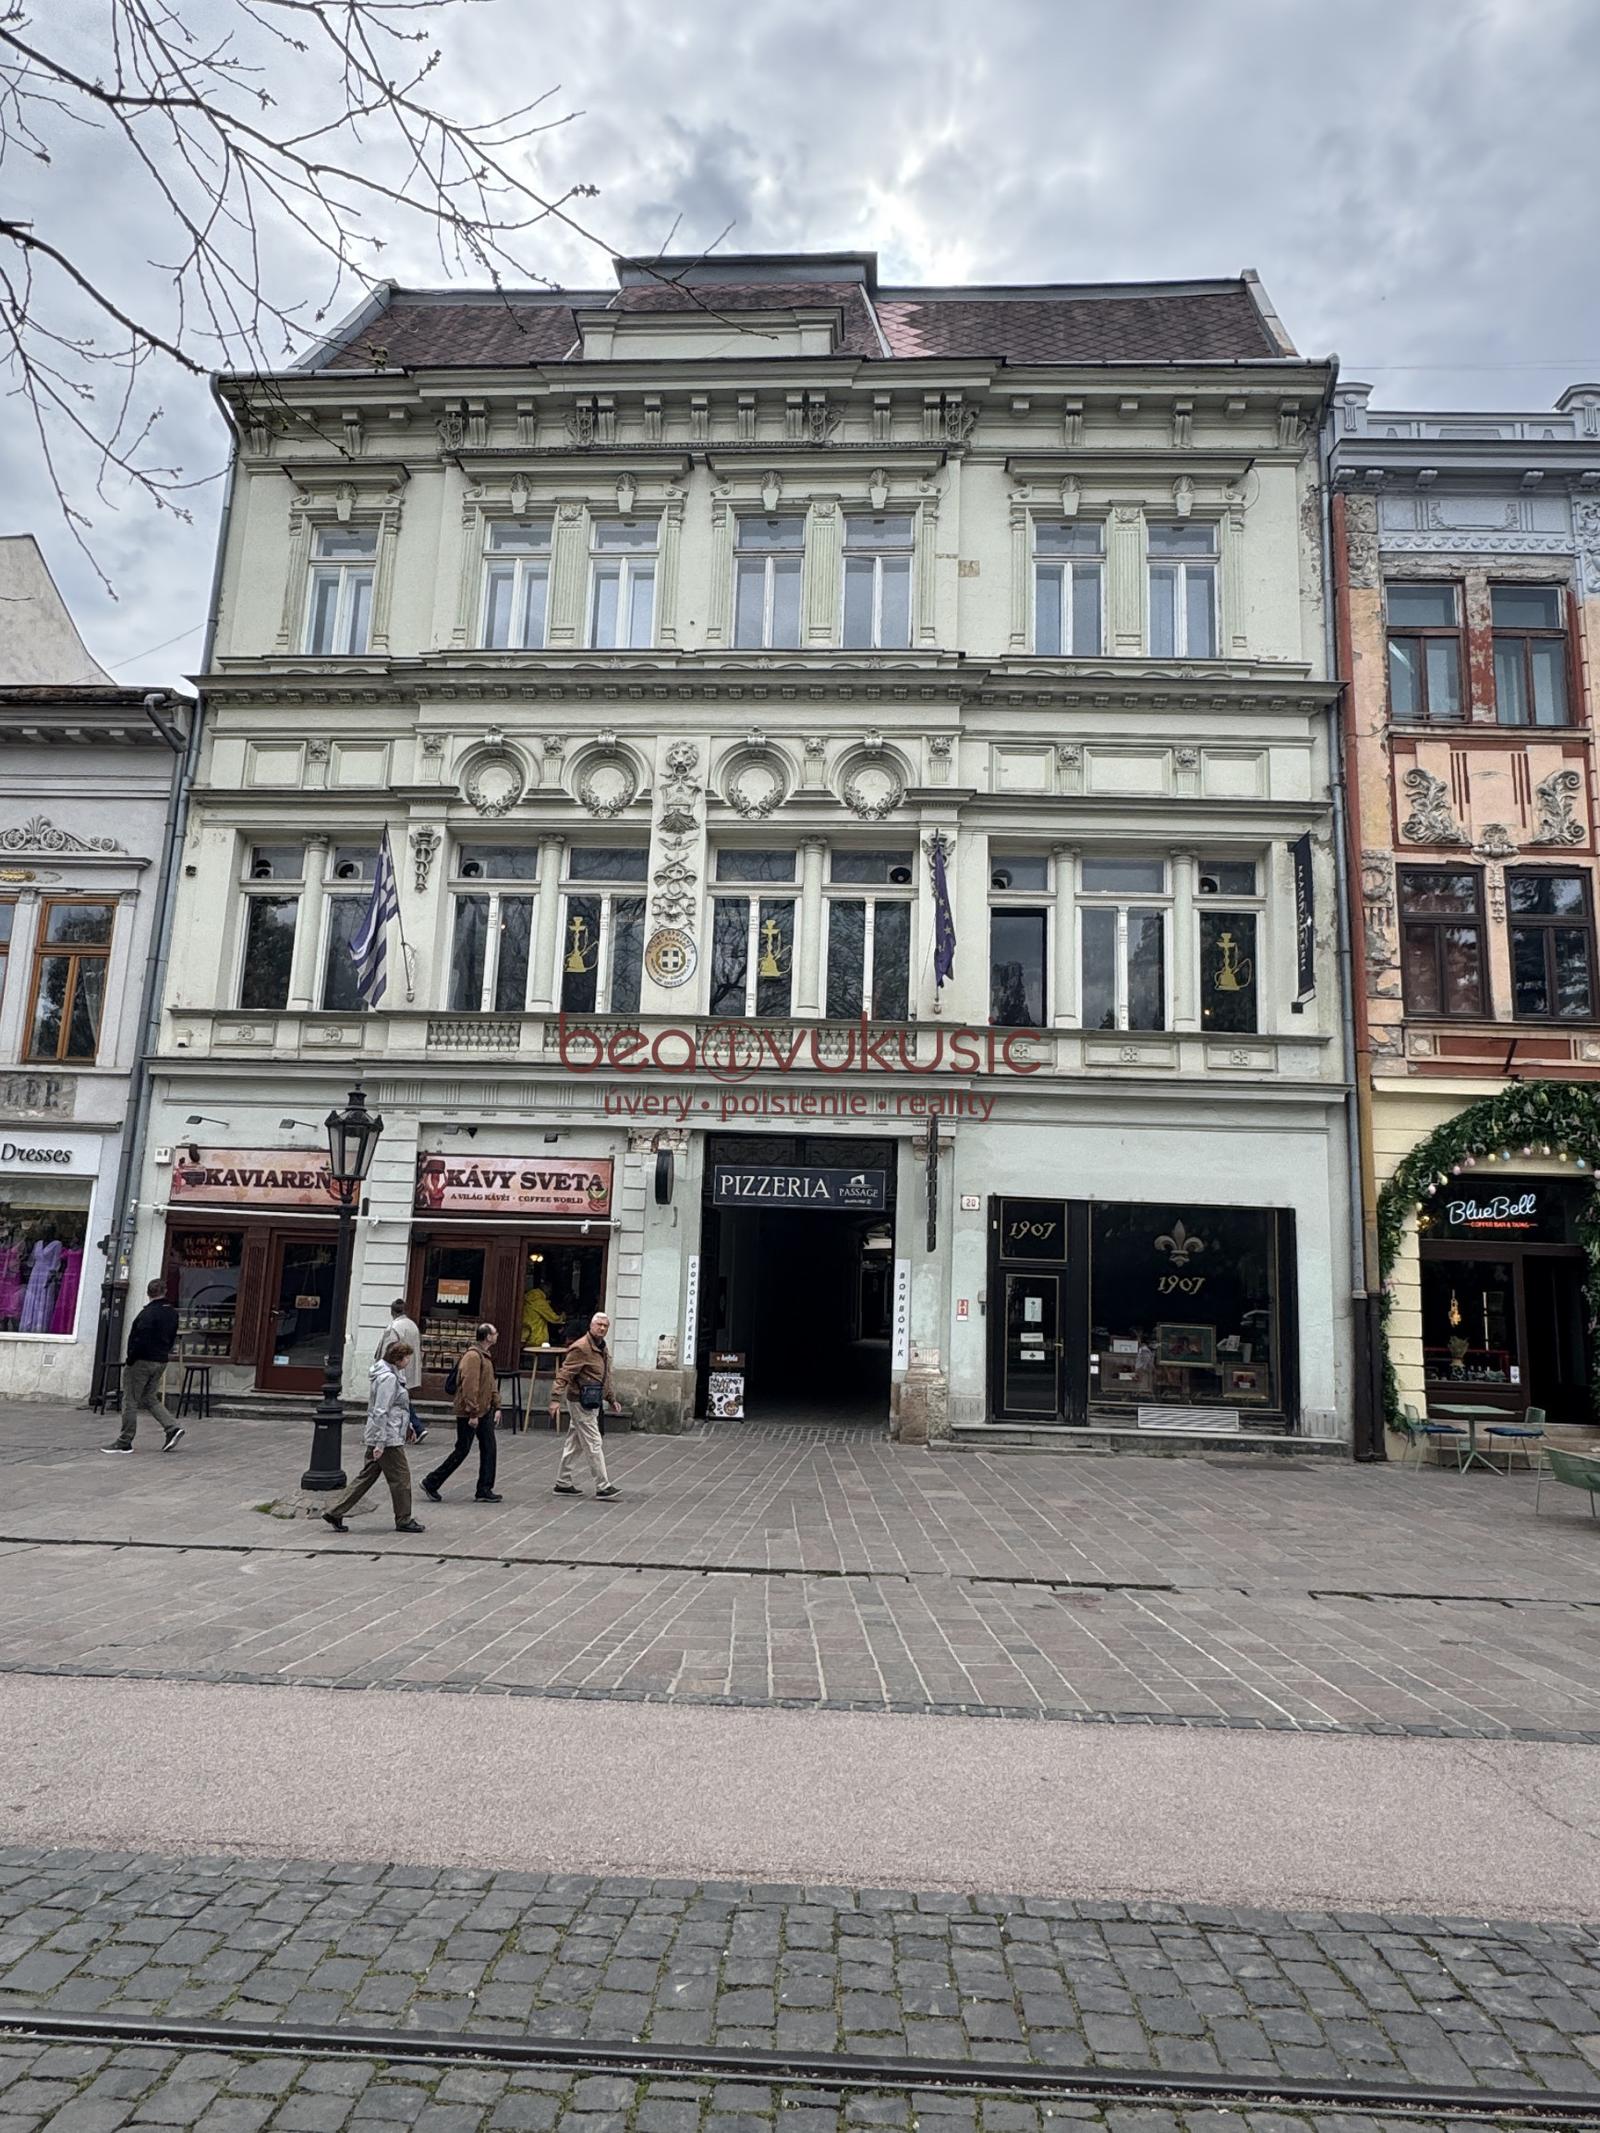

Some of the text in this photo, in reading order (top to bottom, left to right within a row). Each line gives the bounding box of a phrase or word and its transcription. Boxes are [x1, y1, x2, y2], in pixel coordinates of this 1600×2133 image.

[1, 1143, 73, 1163] Dresses
[447, 1165, 605, 1192] KÁVY SVETA
[719, 1174, 879, 1199] PIZZERIA PASSAGE
[518, 1195, 551, 1204] COFFEE
[553, 1196, 584, 1204] WORLD
[966, 1198, 976, 1207] 20
[1446, 1193, 1537, 1225] BlueBell
[1009, 1220, 1057, 1240] 1907
[1157, 1274, 1205, 1295] 1907
